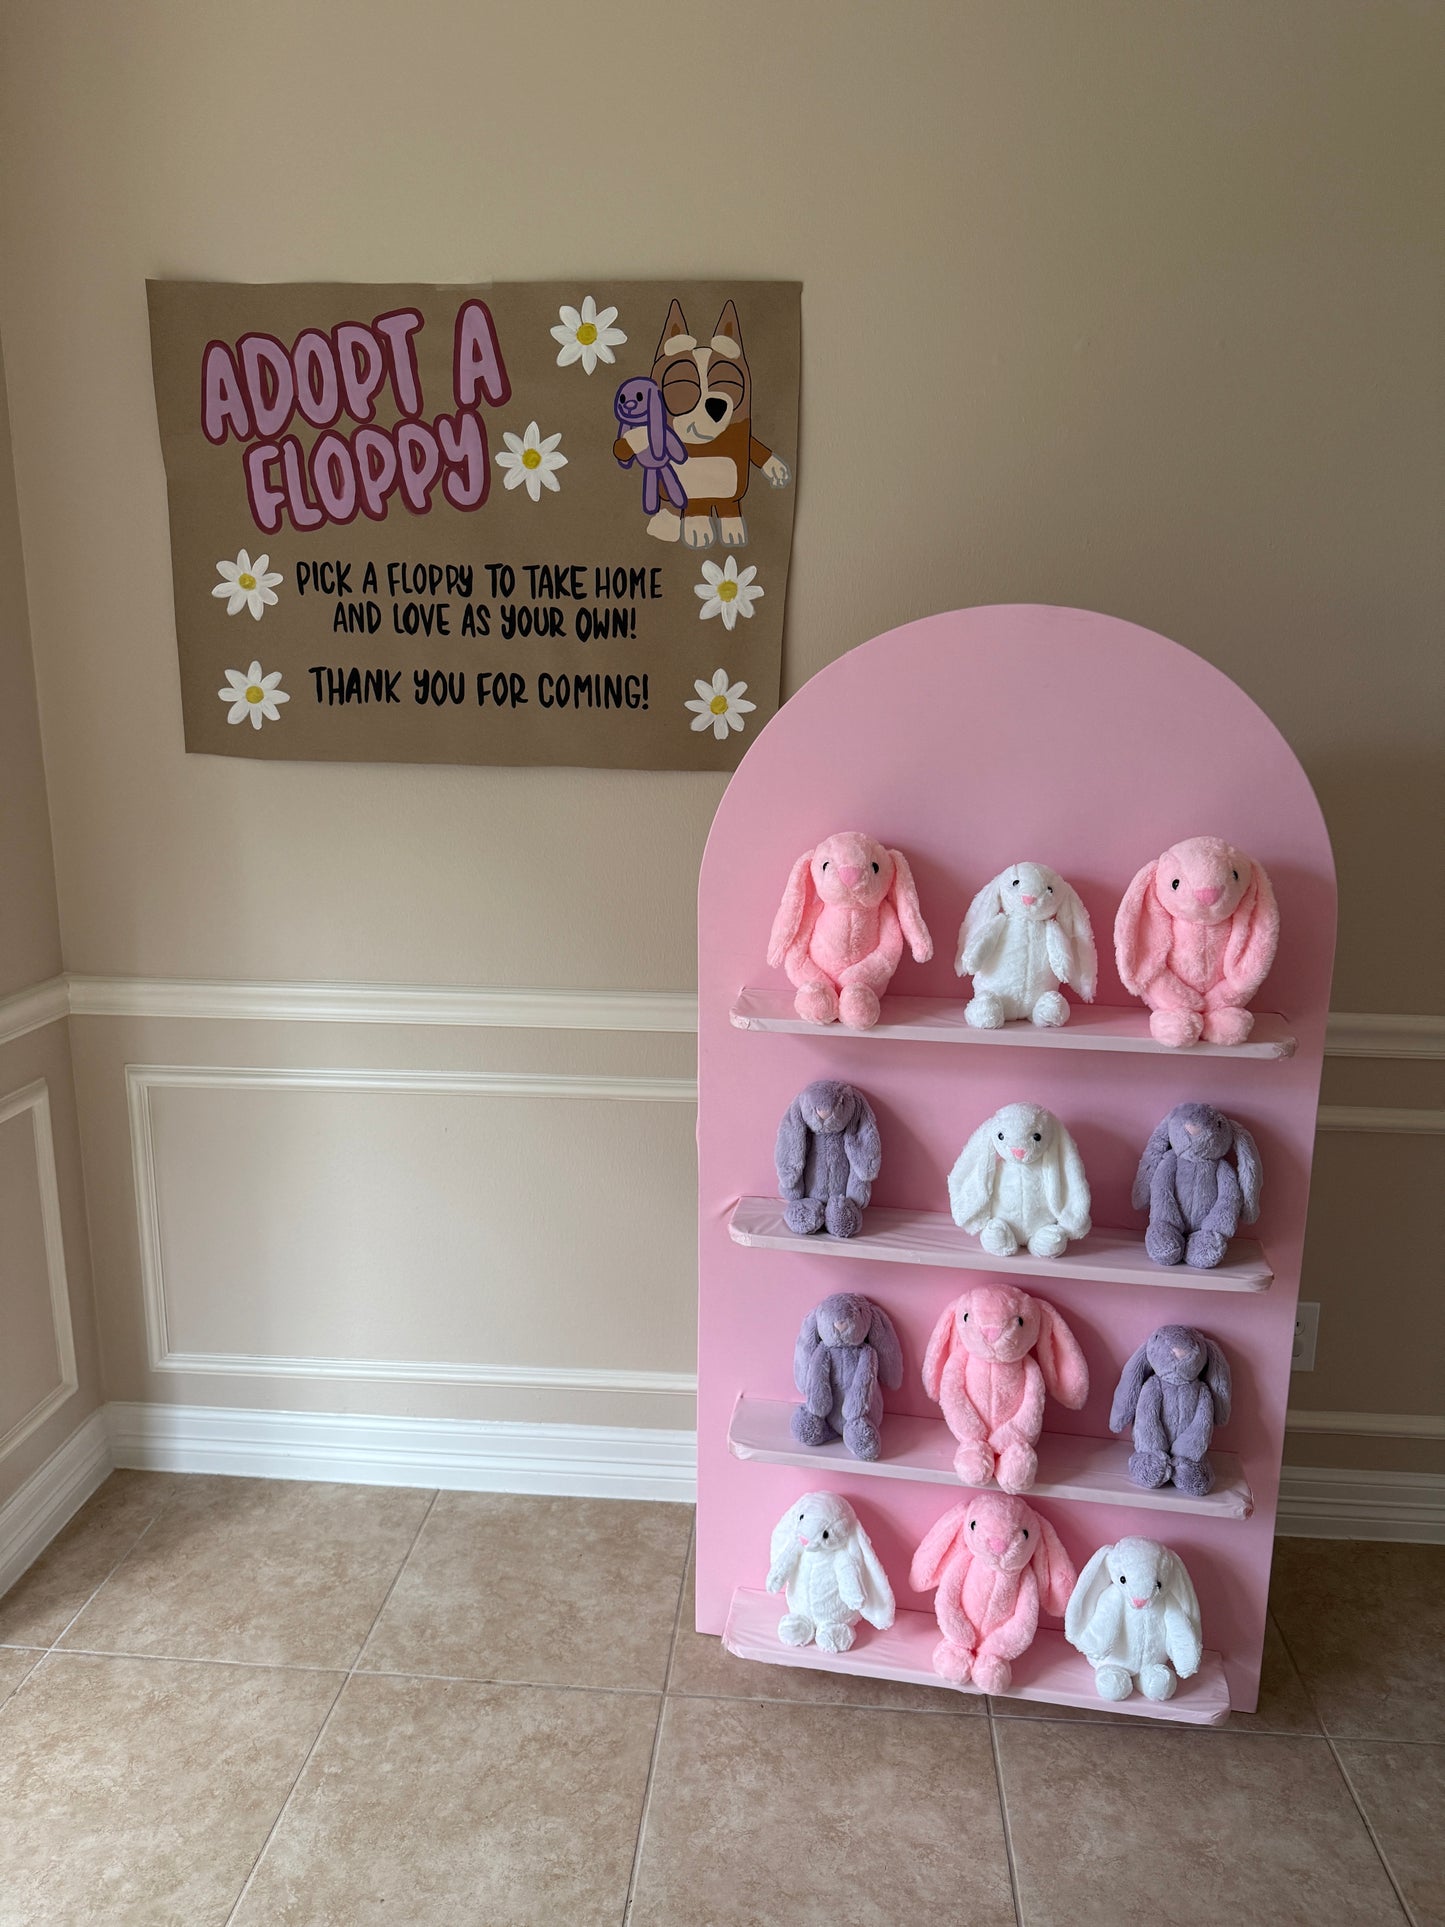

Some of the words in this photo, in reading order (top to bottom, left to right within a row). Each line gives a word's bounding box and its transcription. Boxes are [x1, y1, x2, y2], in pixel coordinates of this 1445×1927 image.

[201, 308, 424, 445] ADOPT
[452, 299, 512, 410] A
[243, 406, 491, 535] FLOPPY
[295, 559, 353, 598] PICK
[362, 561, 378, 595] A
[387, 561, 474, 598] FLOPPY
[484, 562, 516, 599] TO
[521, 564, 588, 600] TAKE
[595, 566, 663, 601] HOME
[333, 600, 382, 635] AND
[392, 601, 451, 638] LOVE
[461, 604, 492, 639] AS
[500, 605, 568, 640] YOUR
[575, 606, 637, 643] OWN!
[307, 666, 402, 707] THANK
[413, 668, 466, 707] YOU
[476, 671, 529, 709] FOR
[537, 672, 649, 711] COMING!
